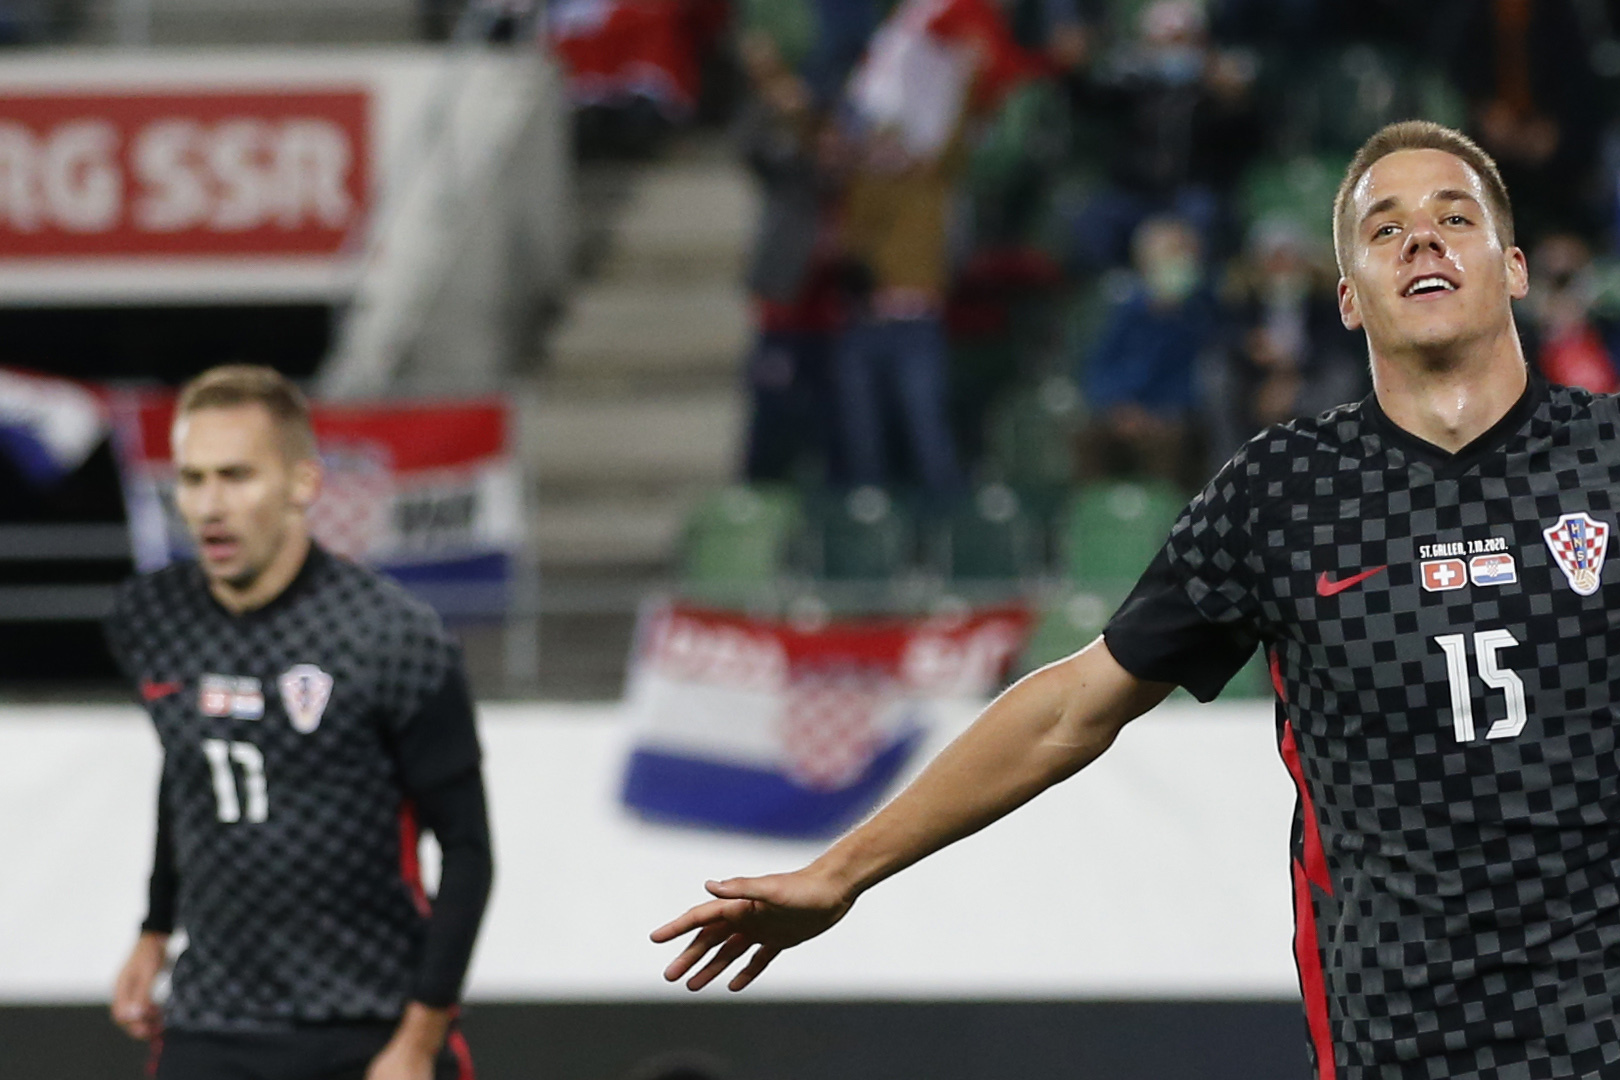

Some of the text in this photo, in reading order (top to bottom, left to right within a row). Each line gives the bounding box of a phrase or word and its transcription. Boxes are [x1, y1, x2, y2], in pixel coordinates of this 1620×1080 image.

[131, 118, 351, 233] SSR
[1434, 629, 1527, 743] 15
[202, 738, 269, 823] 17
